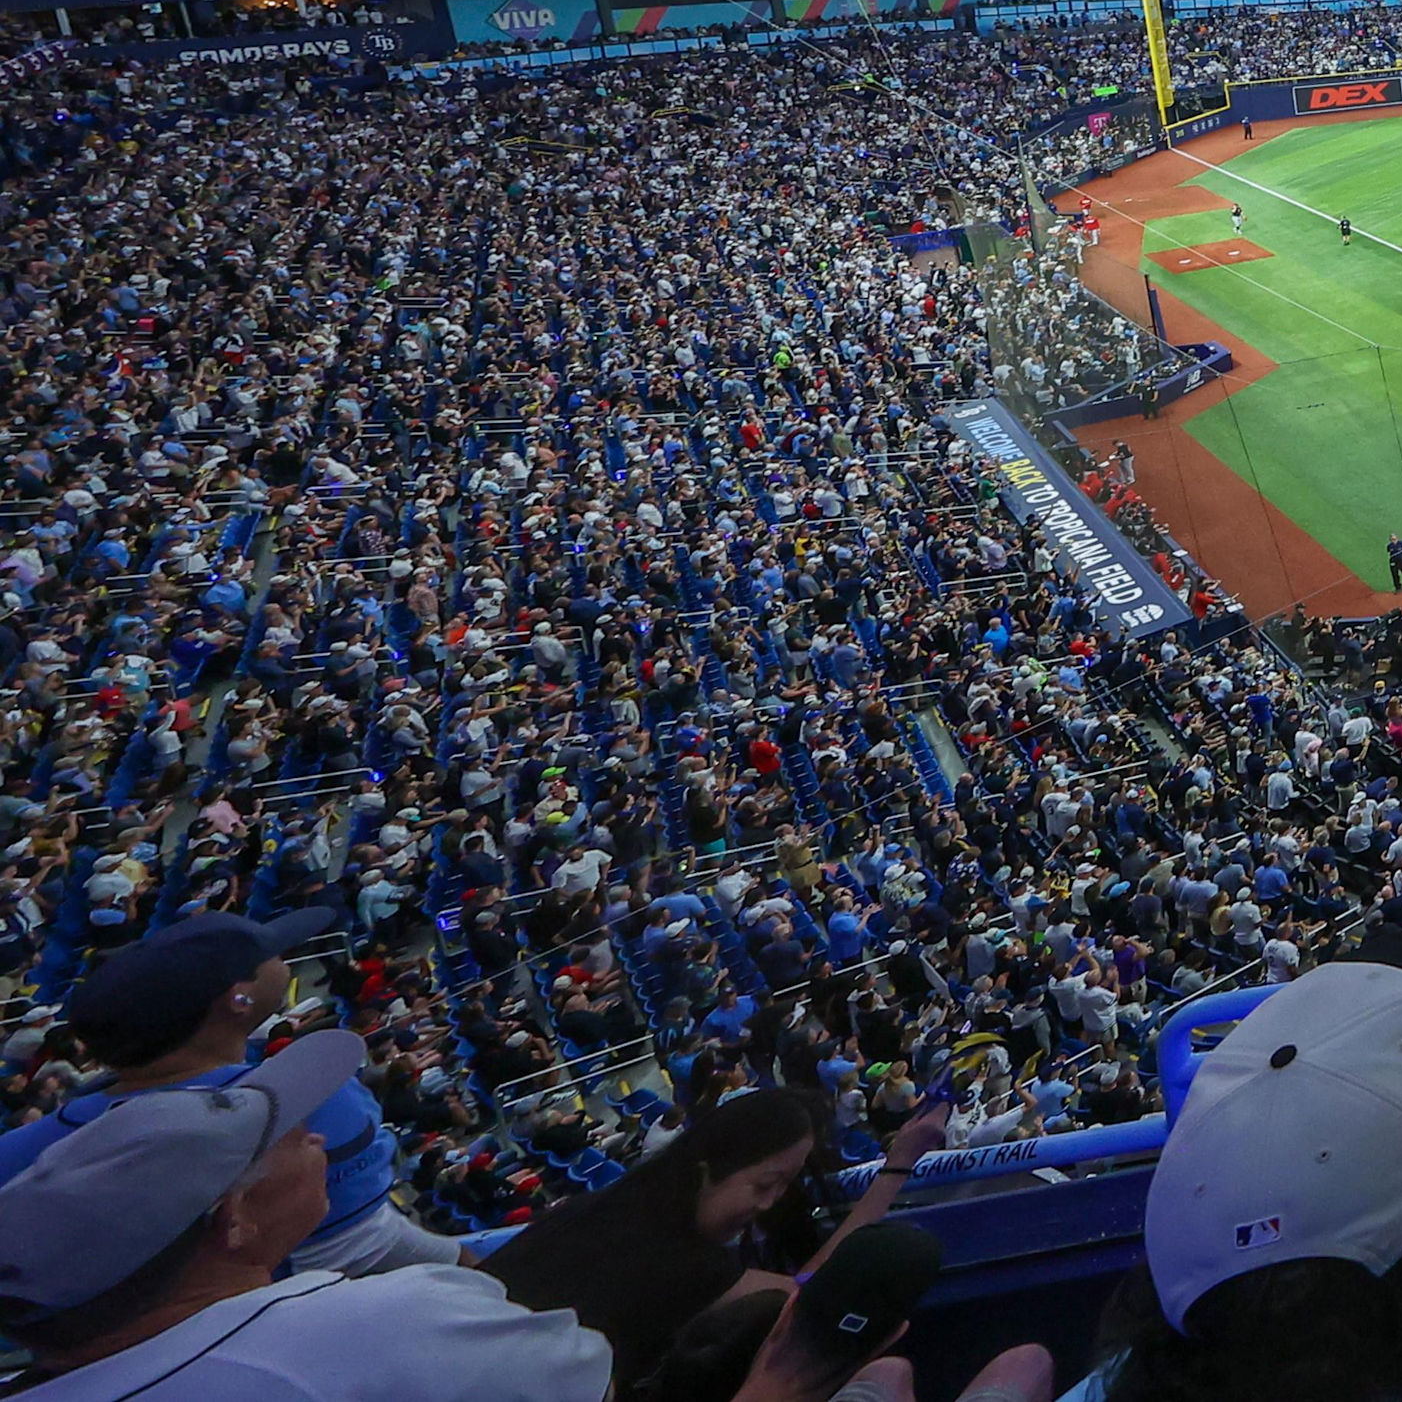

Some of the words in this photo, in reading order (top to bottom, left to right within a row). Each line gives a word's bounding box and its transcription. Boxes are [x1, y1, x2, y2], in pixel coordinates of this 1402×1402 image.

[493, 8, 555, 30] VIVA
[179, 44, 280, 65] SOMOS
[283, 39, 351, 58] RAYS
[368, 33, 396, 51] TB
[1308, 81, 1390, 109] DEX
[966, 416, 1025, 461] WELCOME
[1000, 459, 1047, 490] BACK
[1022, 484, 1060, 504] TO
[1035, 499, 1113, 570] TROPICANA
[1086, 562, 1144, 605] FIELD
[912, 1148, 990, 1178] GAINST
[993, 1140, 1040, 1166] RAIL
